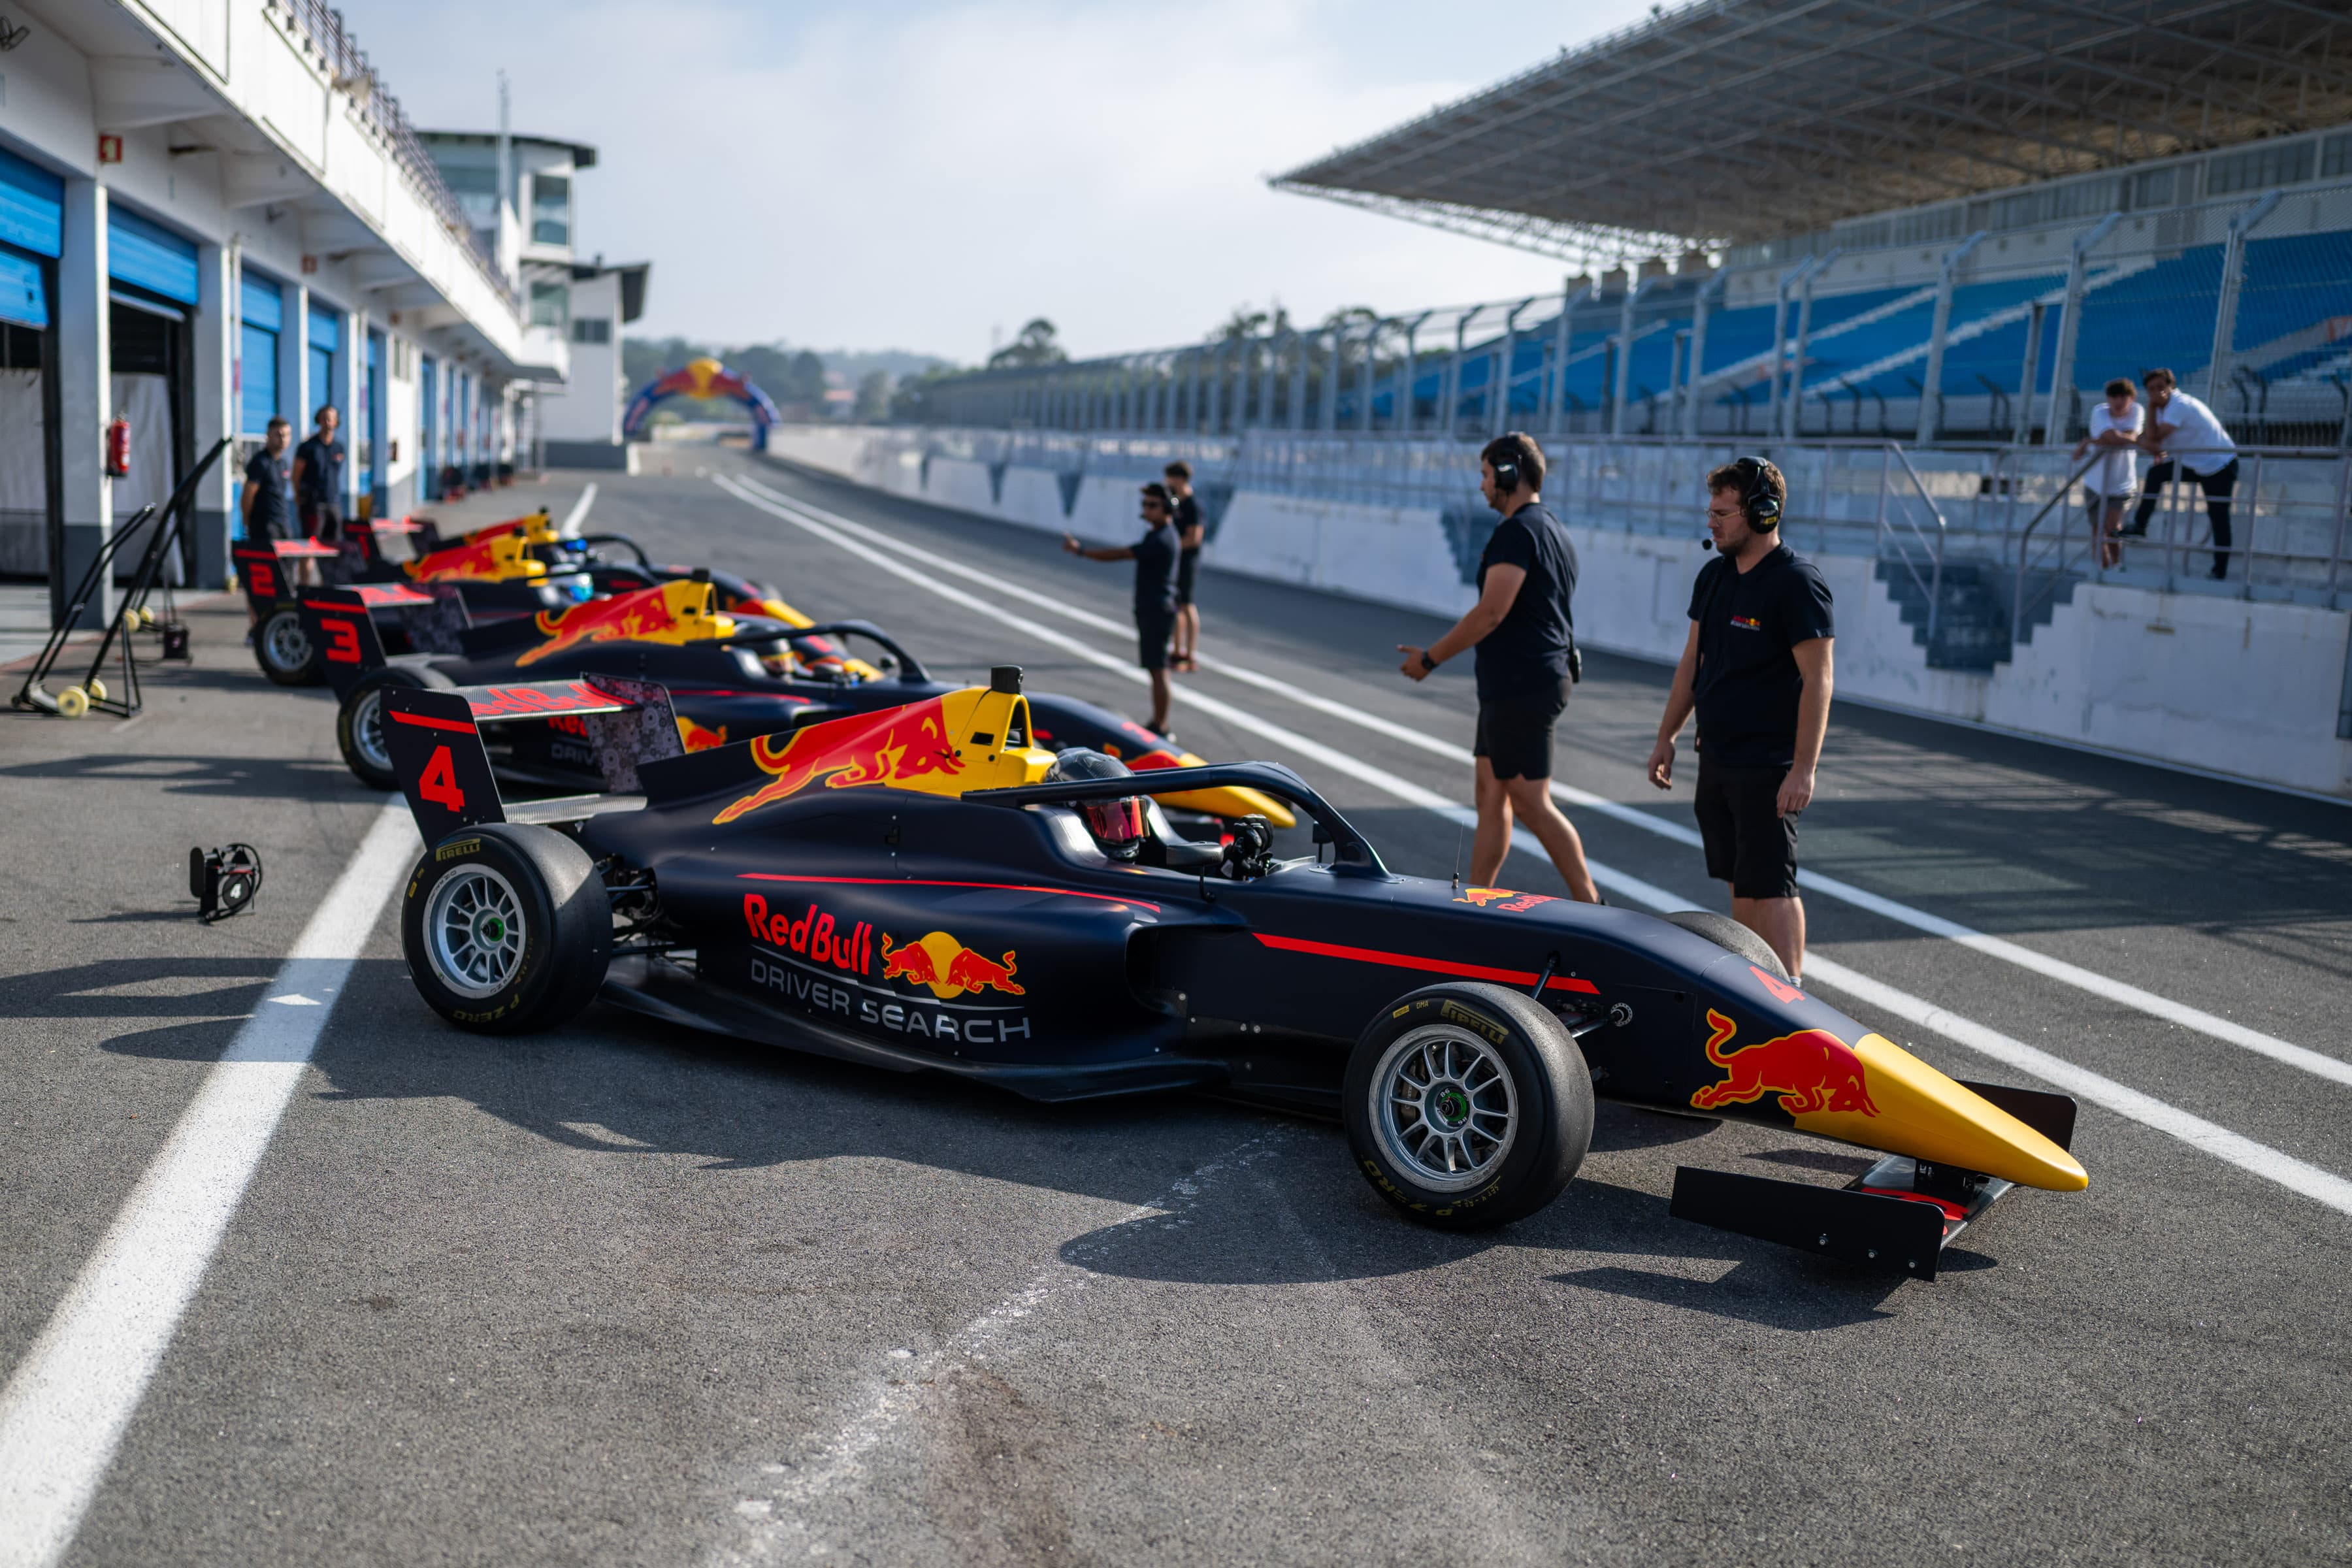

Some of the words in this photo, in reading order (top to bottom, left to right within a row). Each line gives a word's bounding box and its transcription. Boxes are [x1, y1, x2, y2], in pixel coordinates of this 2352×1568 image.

[249, 562, 277, 596] 2
[321, 617, 362, 664] 3
[419, 745, 465, 813] 4
[435, 838, 481, 862] PIRELLI
[230, 883, 241, 899] 4
[751, 958, 850, 1016] DRIVER
[860, 998, 1031, 1043] SEARCH
[1748, 965, 1806, 1004] 4
[1440, 999, 1509, 1045] PIRELLI
